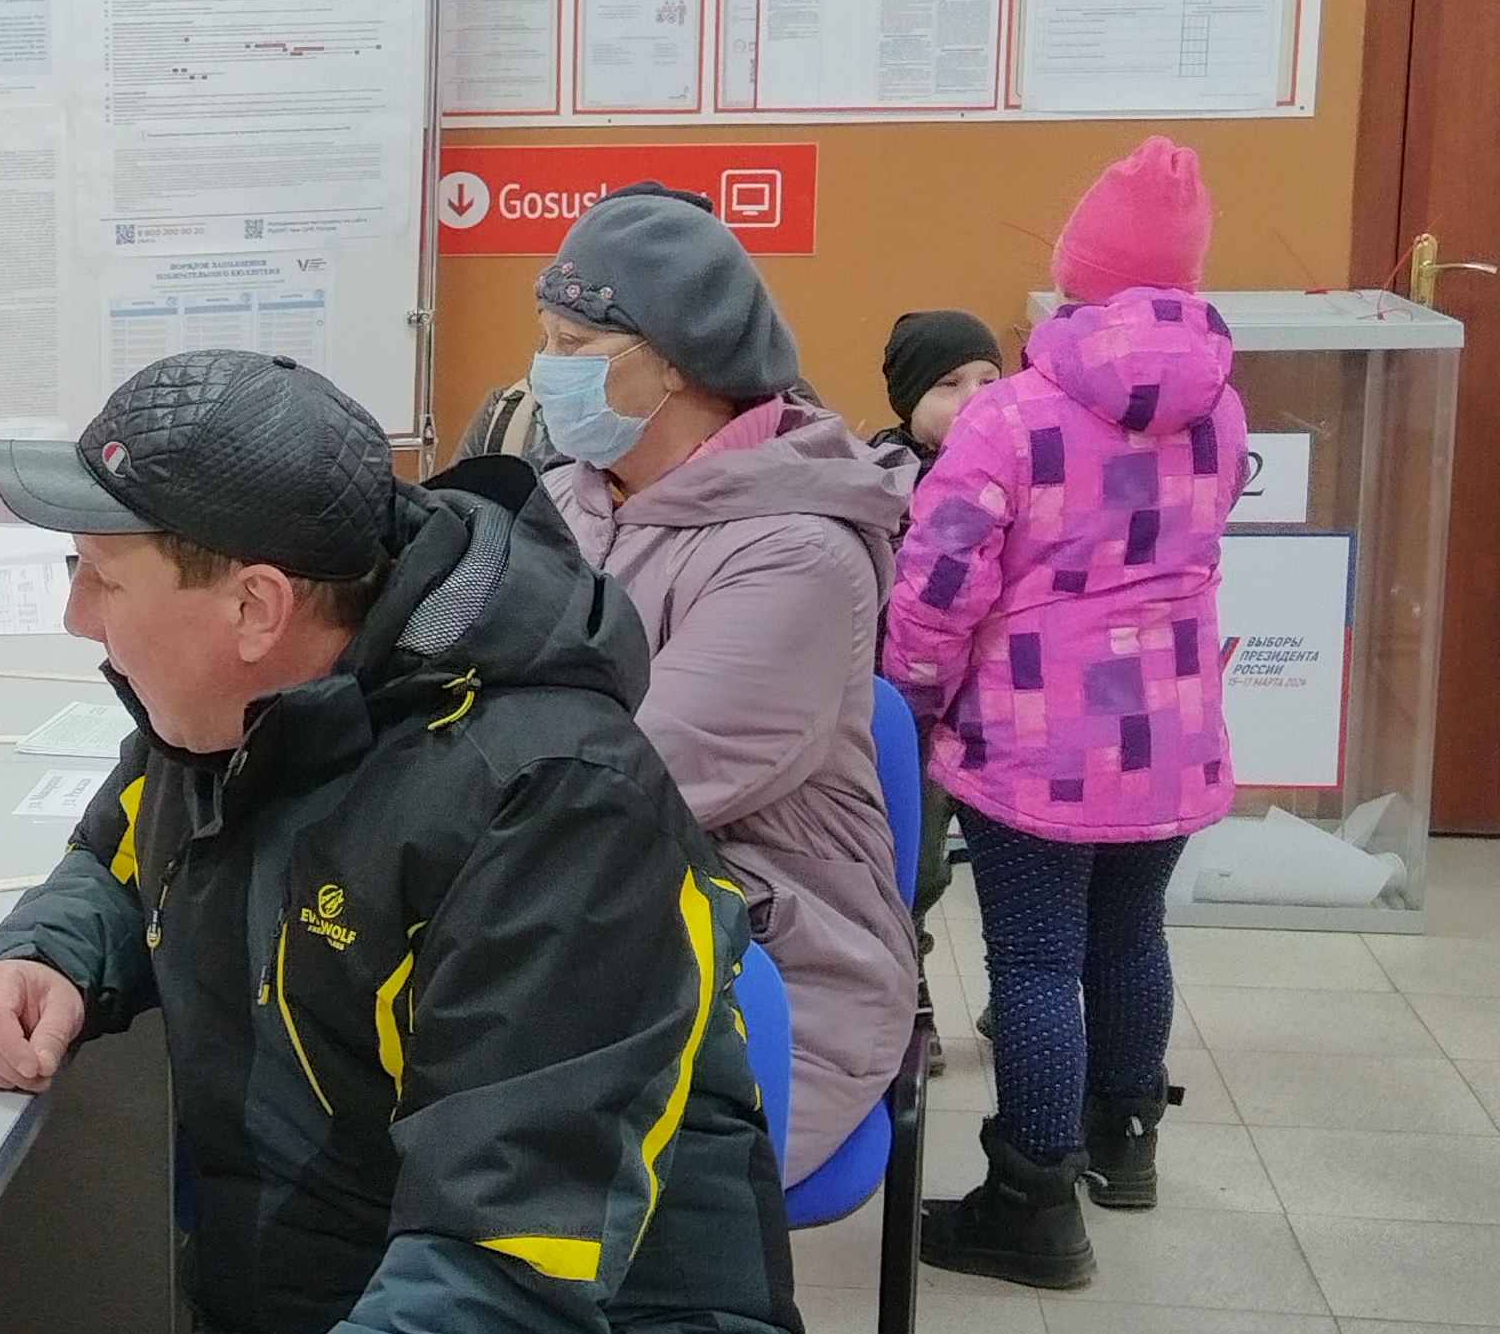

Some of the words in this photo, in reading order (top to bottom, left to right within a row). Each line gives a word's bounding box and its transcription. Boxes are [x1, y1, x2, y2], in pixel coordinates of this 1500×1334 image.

[162, 228, 179, 236] 200
[181, 227, 192, 235] 00
[193, 227, 205, 235] 20
[1247, 636, 1304, 648] ВЫБОРЫ
[1240, 650, 1320, 663] ПРЕЗИДЕНТА
[1233, 664, 1285, 675] РОССИИ
[1253, 677, 1283, 687] МАРТА
[1284, 677, 1307, 687] 2024
